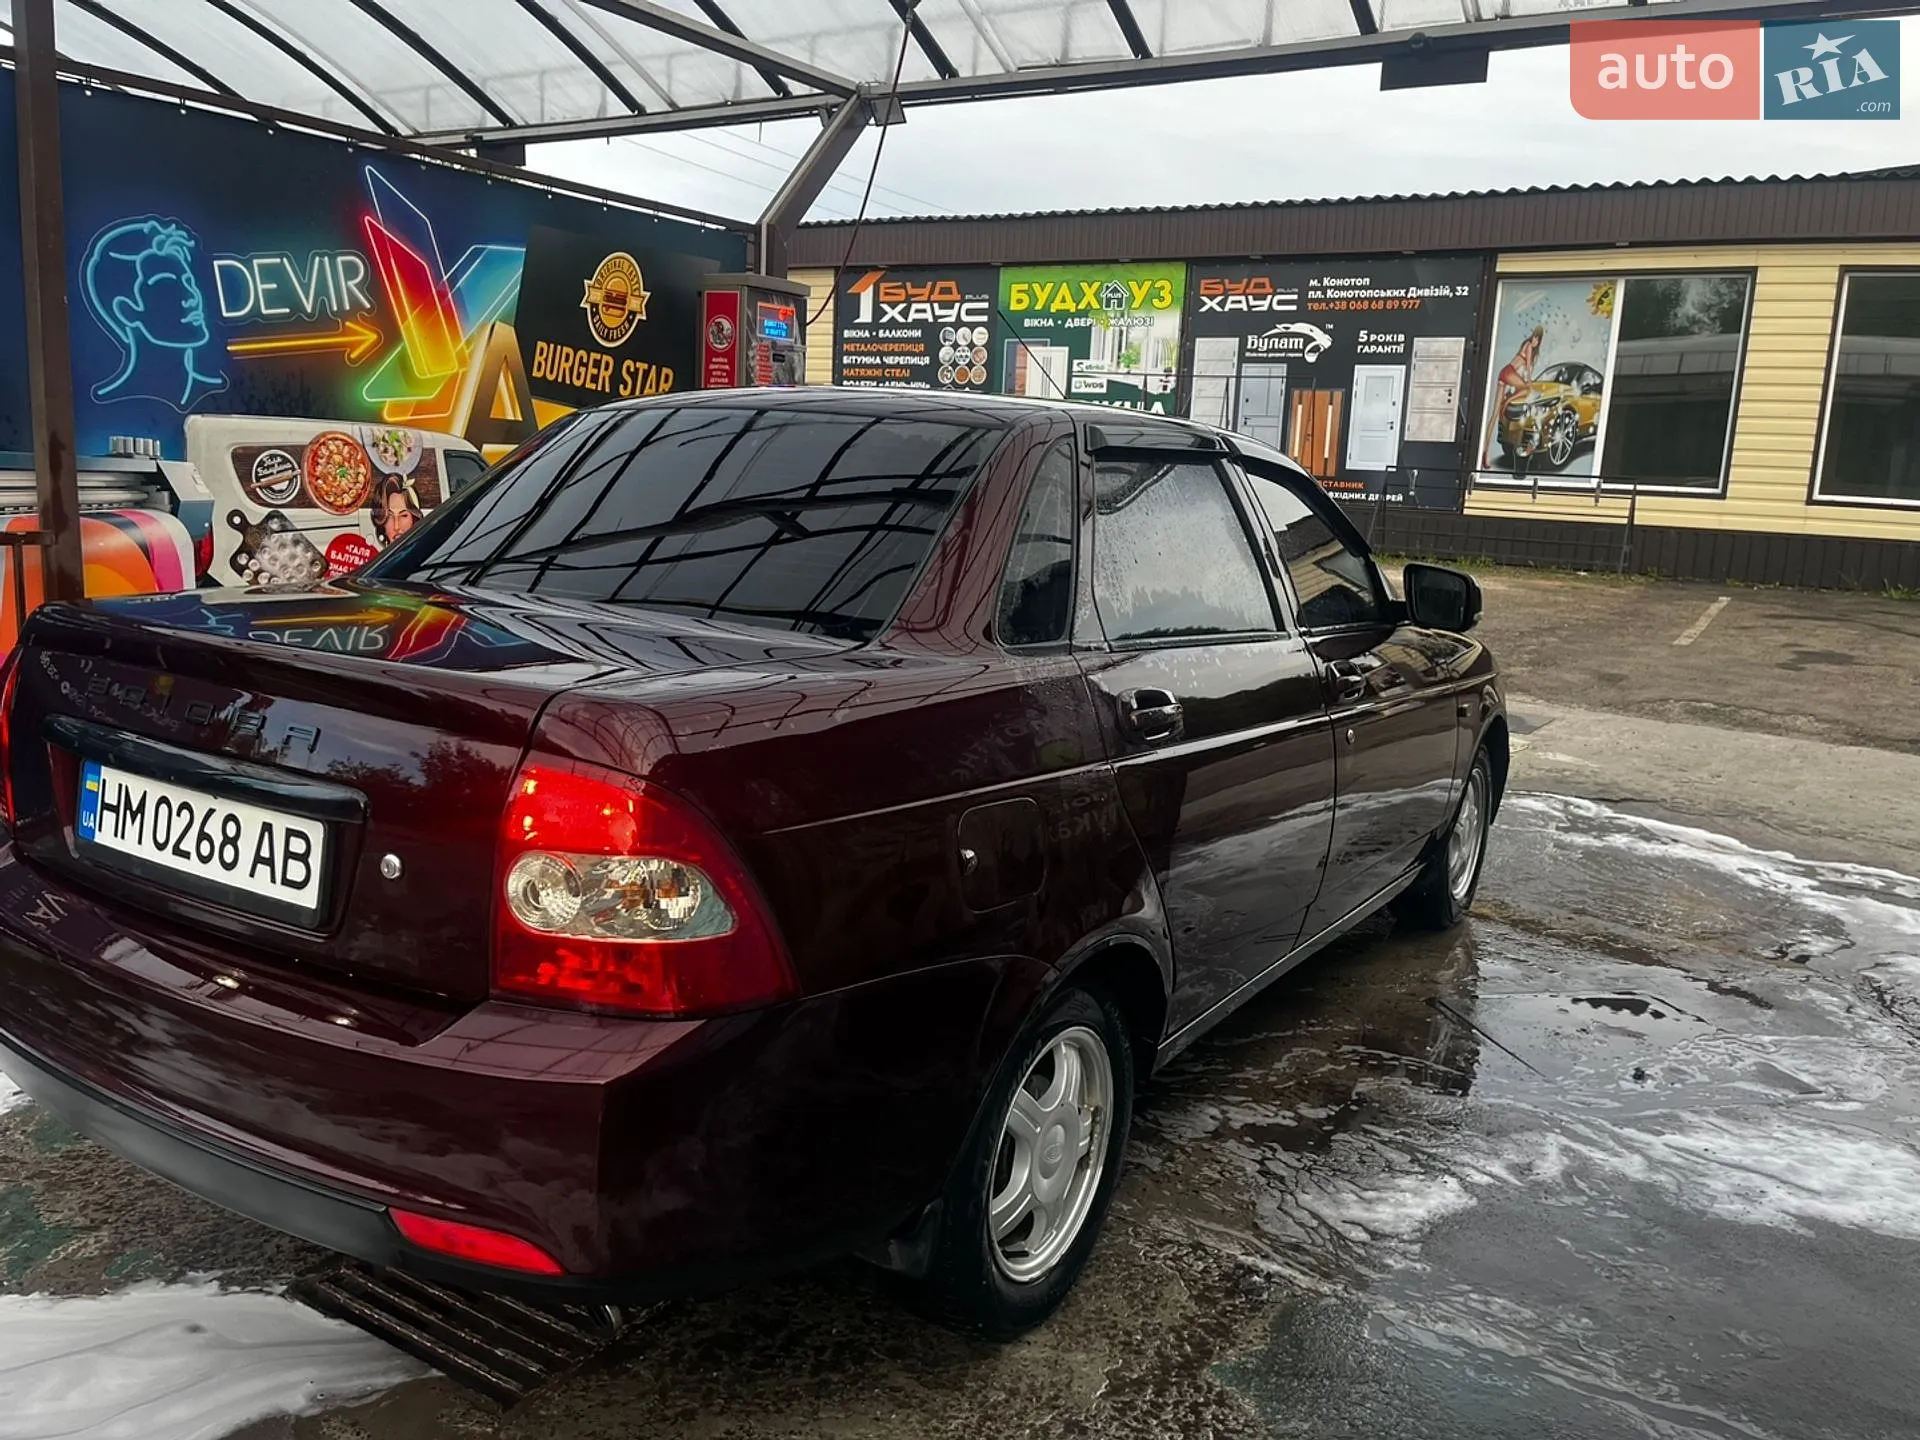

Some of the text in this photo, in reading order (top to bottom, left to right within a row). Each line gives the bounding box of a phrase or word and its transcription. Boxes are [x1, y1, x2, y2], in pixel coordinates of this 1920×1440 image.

[213, 255, 372, 318] DEVIR
[1200, 277, 1274, 295] БУД
[1308, 277, 1370, 287] м. Конотоп
[879, 281, 962, 301] БУД
[1308, 290, 1325, 299] пл.
[1326, 288, 1406, 299] Конотопських
[1455, 286, 1469, 297] 32
[1198, 294, 1298, 312] ХАУС
[1349, 301, 1369, 311] 068
[1370, 301, 1384, 311] 68
[1385, 300, 1399, 310] 89
[1401, 300, 1421, 310] 977
[879, 302, 989, 323] ХАУС
[1024, 316, 1154, 328] ВІКНА ДВЕРІ ЖАЛЮЗІ
[610, 321, 630, 340] FRESH
[878, 329, 922, 338] БАЛКОНИ
[1358, 330, 1405, 343] 5 РОКІВ
[1357, 343, 1405, 354] ГАРАНТІЇ
[532, 340, 614, 393] BURGER
[883, 355, 930, 366] ЧЕРЕПИЦЯ
[884, 368, 911, 377] СТЕЛІ
[82, 811, 95, 829] UA
